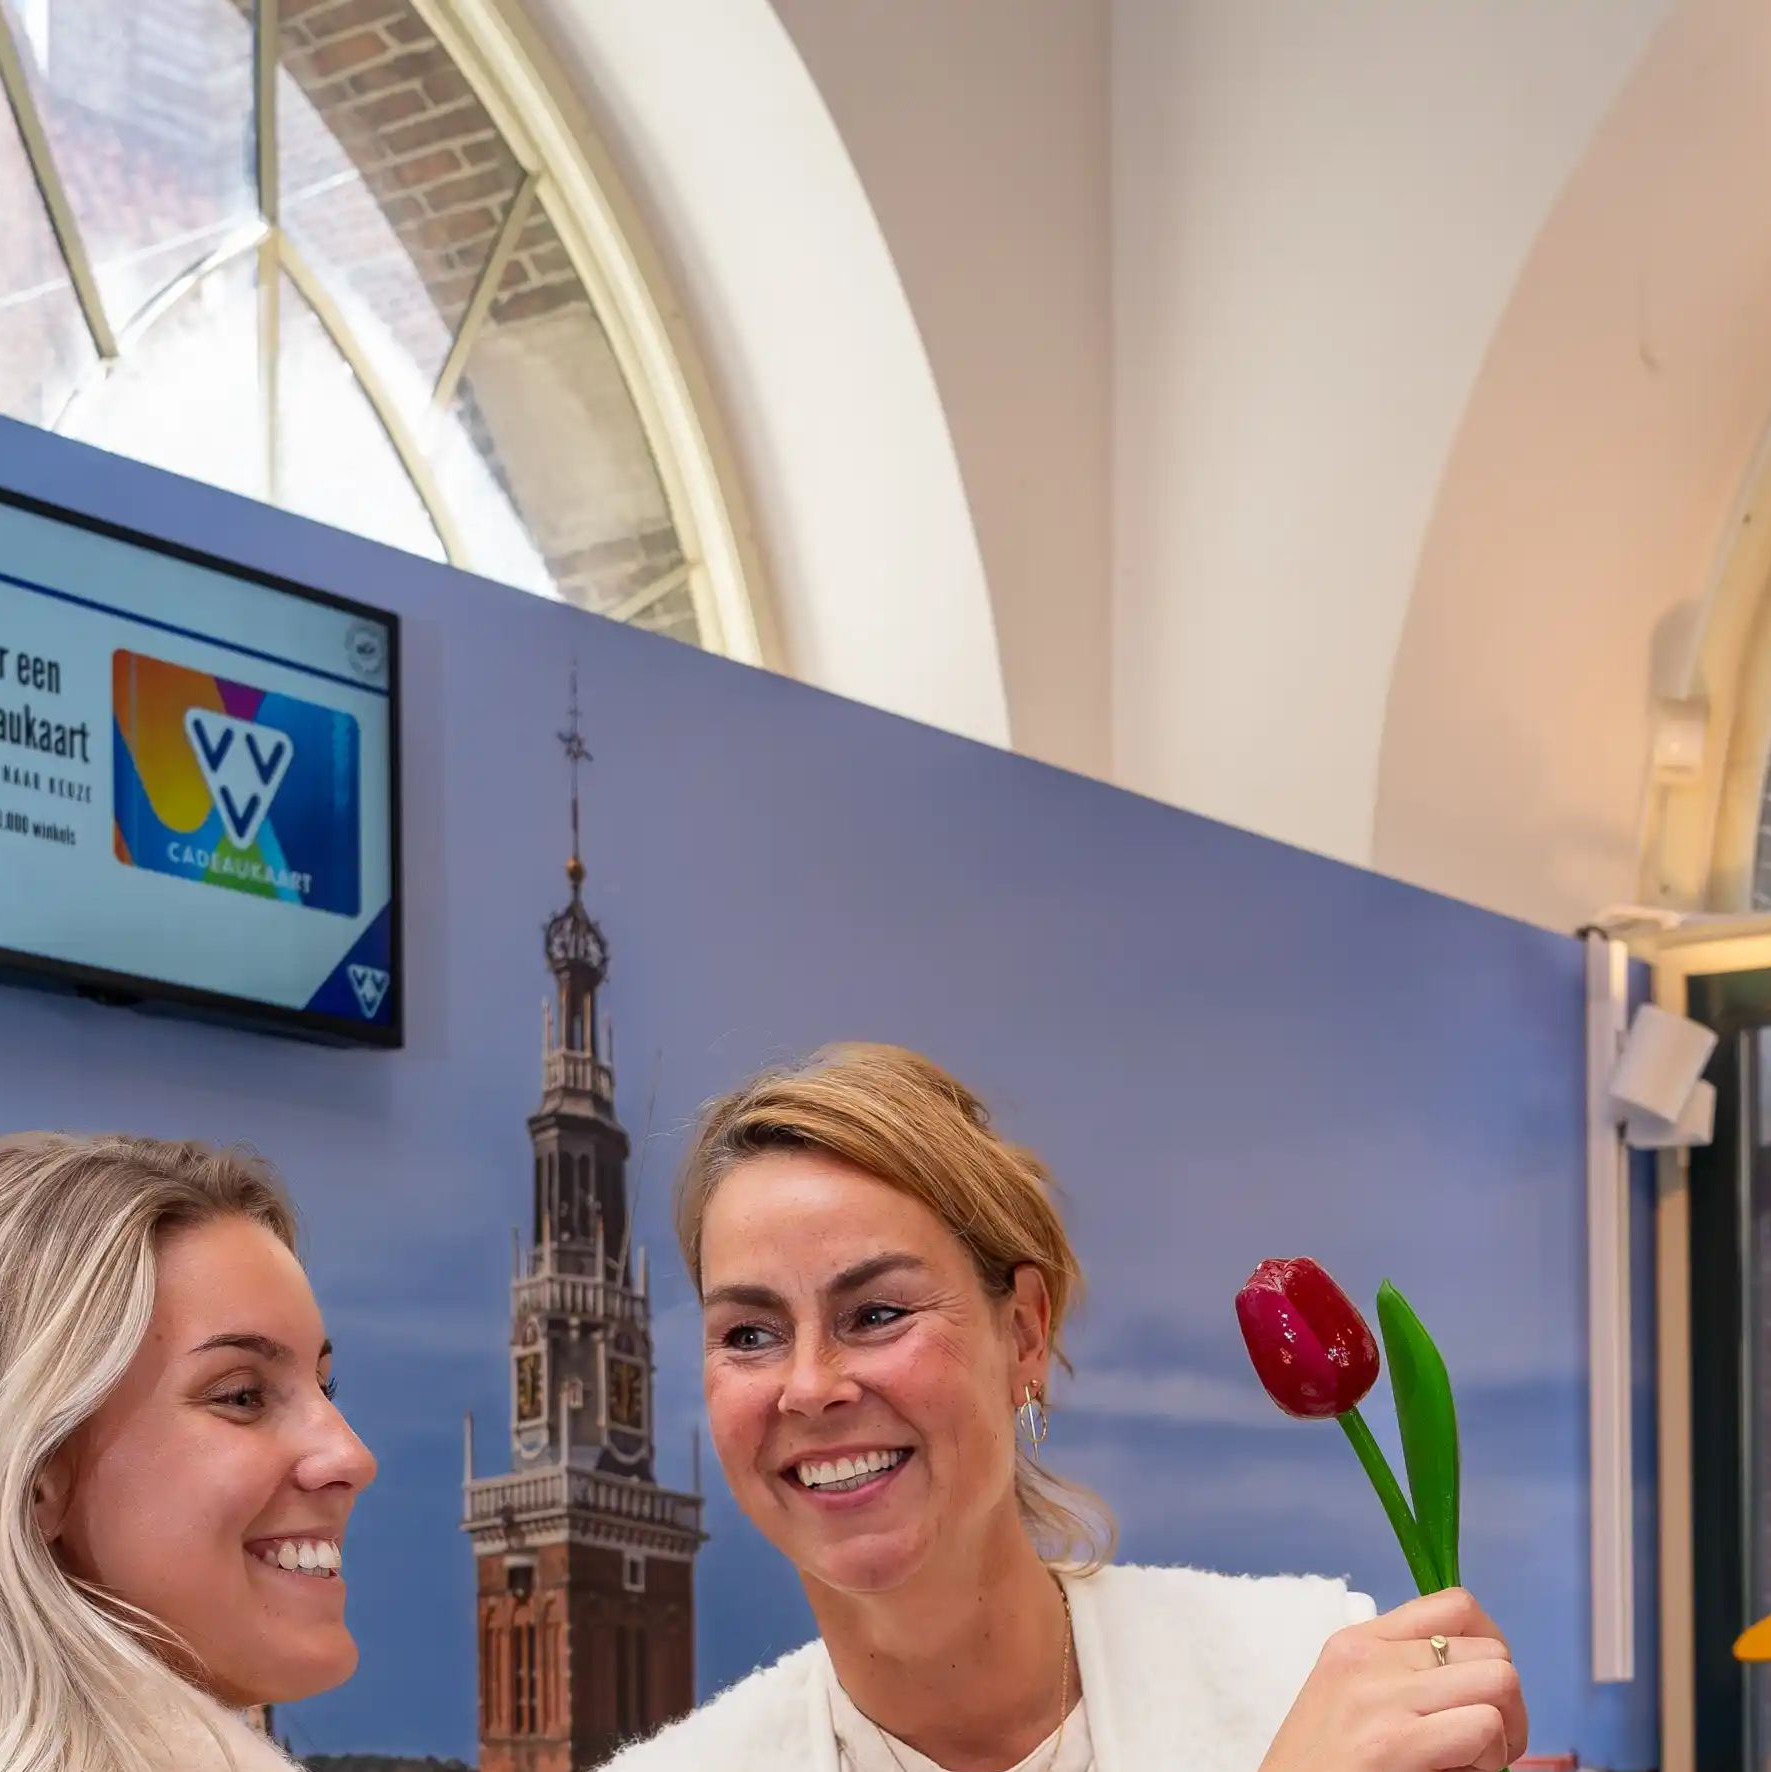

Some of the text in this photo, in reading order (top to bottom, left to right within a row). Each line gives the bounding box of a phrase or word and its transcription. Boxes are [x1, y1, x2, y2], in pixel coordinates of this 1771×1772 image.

[18, 652, 61, 694] een
[4, 765, 40, 790] NAAR
[49, 777, 92, 803] KEUZE
[32, 820, 76, 845] winkels
[166, 842, 313, 894] CADEAUKAART
